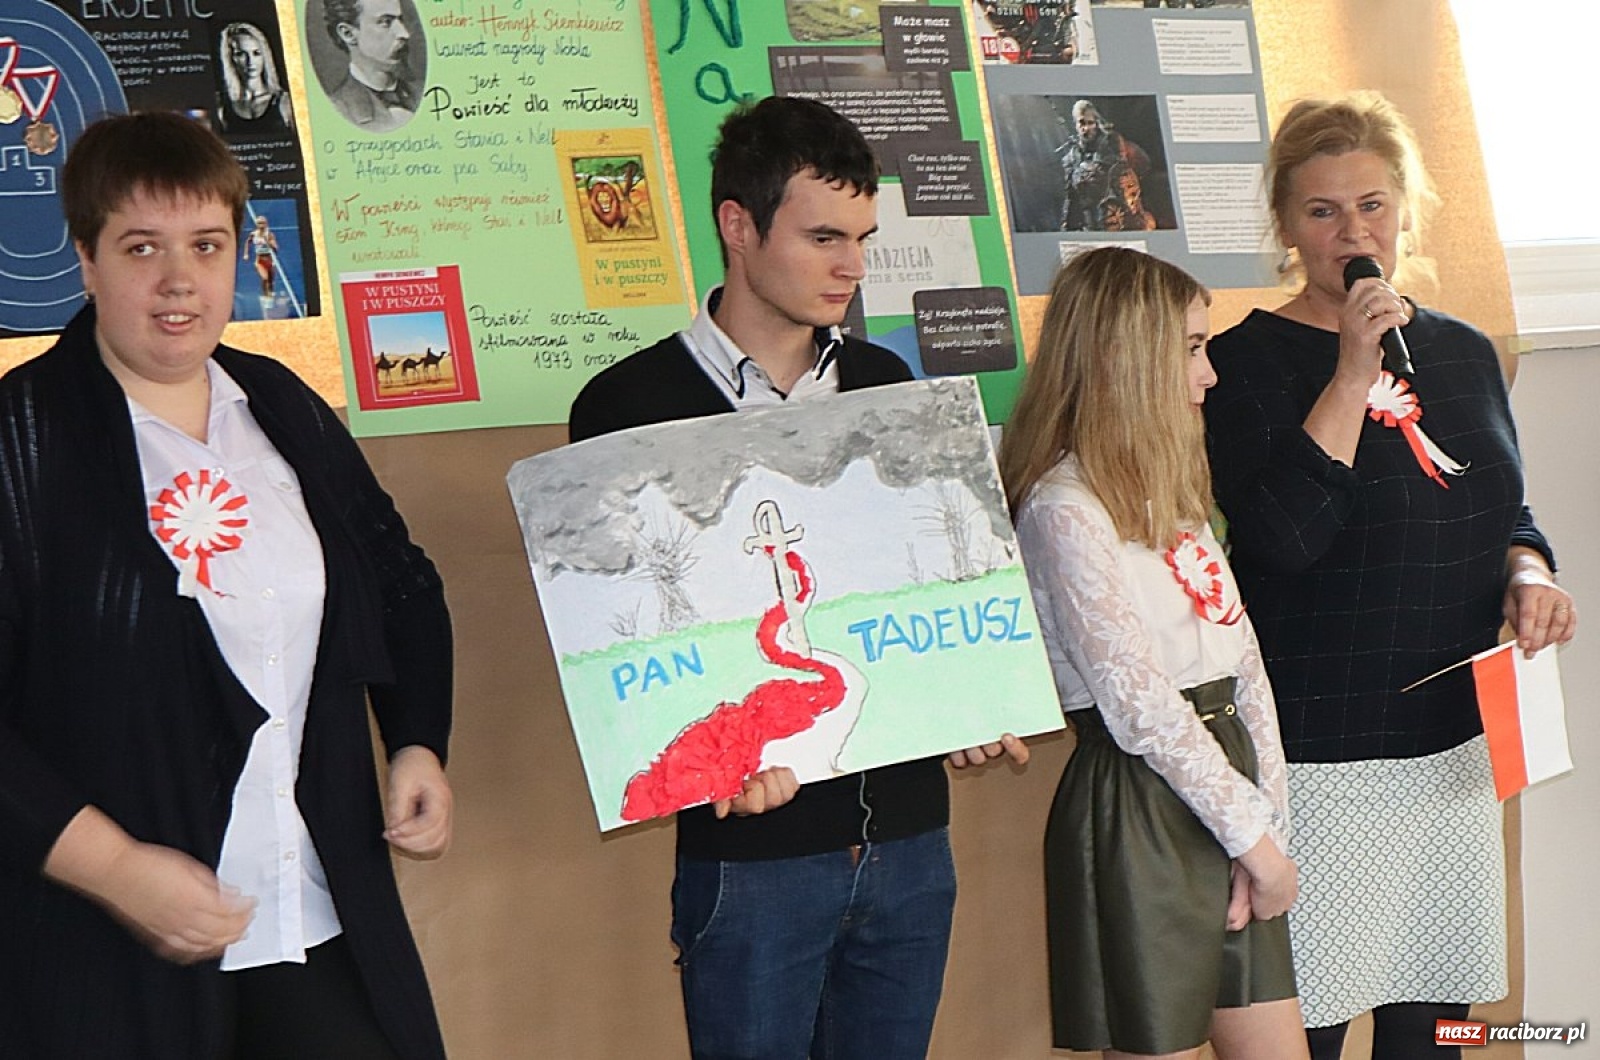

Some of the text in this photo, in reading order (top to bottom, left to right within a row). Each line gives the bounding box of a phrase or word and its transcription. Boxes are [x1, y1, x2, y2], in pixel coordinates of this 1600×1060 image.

[429, 12, 474, 28] autor:
[477, 5, 540, 42] Henryk
[893, 14, 951, 28] Może masz
[902, 30, 947, 46] w głowie
[983, 38, 999, 56] 18
[516, 71, 537, 87] to
[423, 86, 640, 121] Powieść dla młodzieży
[346, 132, 443, 161] przygodach
[528, 121, 559, 146] Nell
[11, 154, 21, 166] 1
[35, 171, 45, 187] 3
[404, 164, 443, 177] oraz
[330, 192, 361, 222] W
[613, 255, 662, 271] pustyni
[618, 272, 669, 289] puszczy
[897, 270, 934, 282] sens
[364, 283, 440, 298] W PUSTYNI
[362, 294, 446, 311] I W PUSZCZY
[469, 304, 613, 328] Powieść została
[479, 332, 569, 351] sfilmowana
[607, 326, 641, 343] roku
[533, 350, 573, 369] 1973
[611, 597, 1033, 702] PAN TADEUSZ
